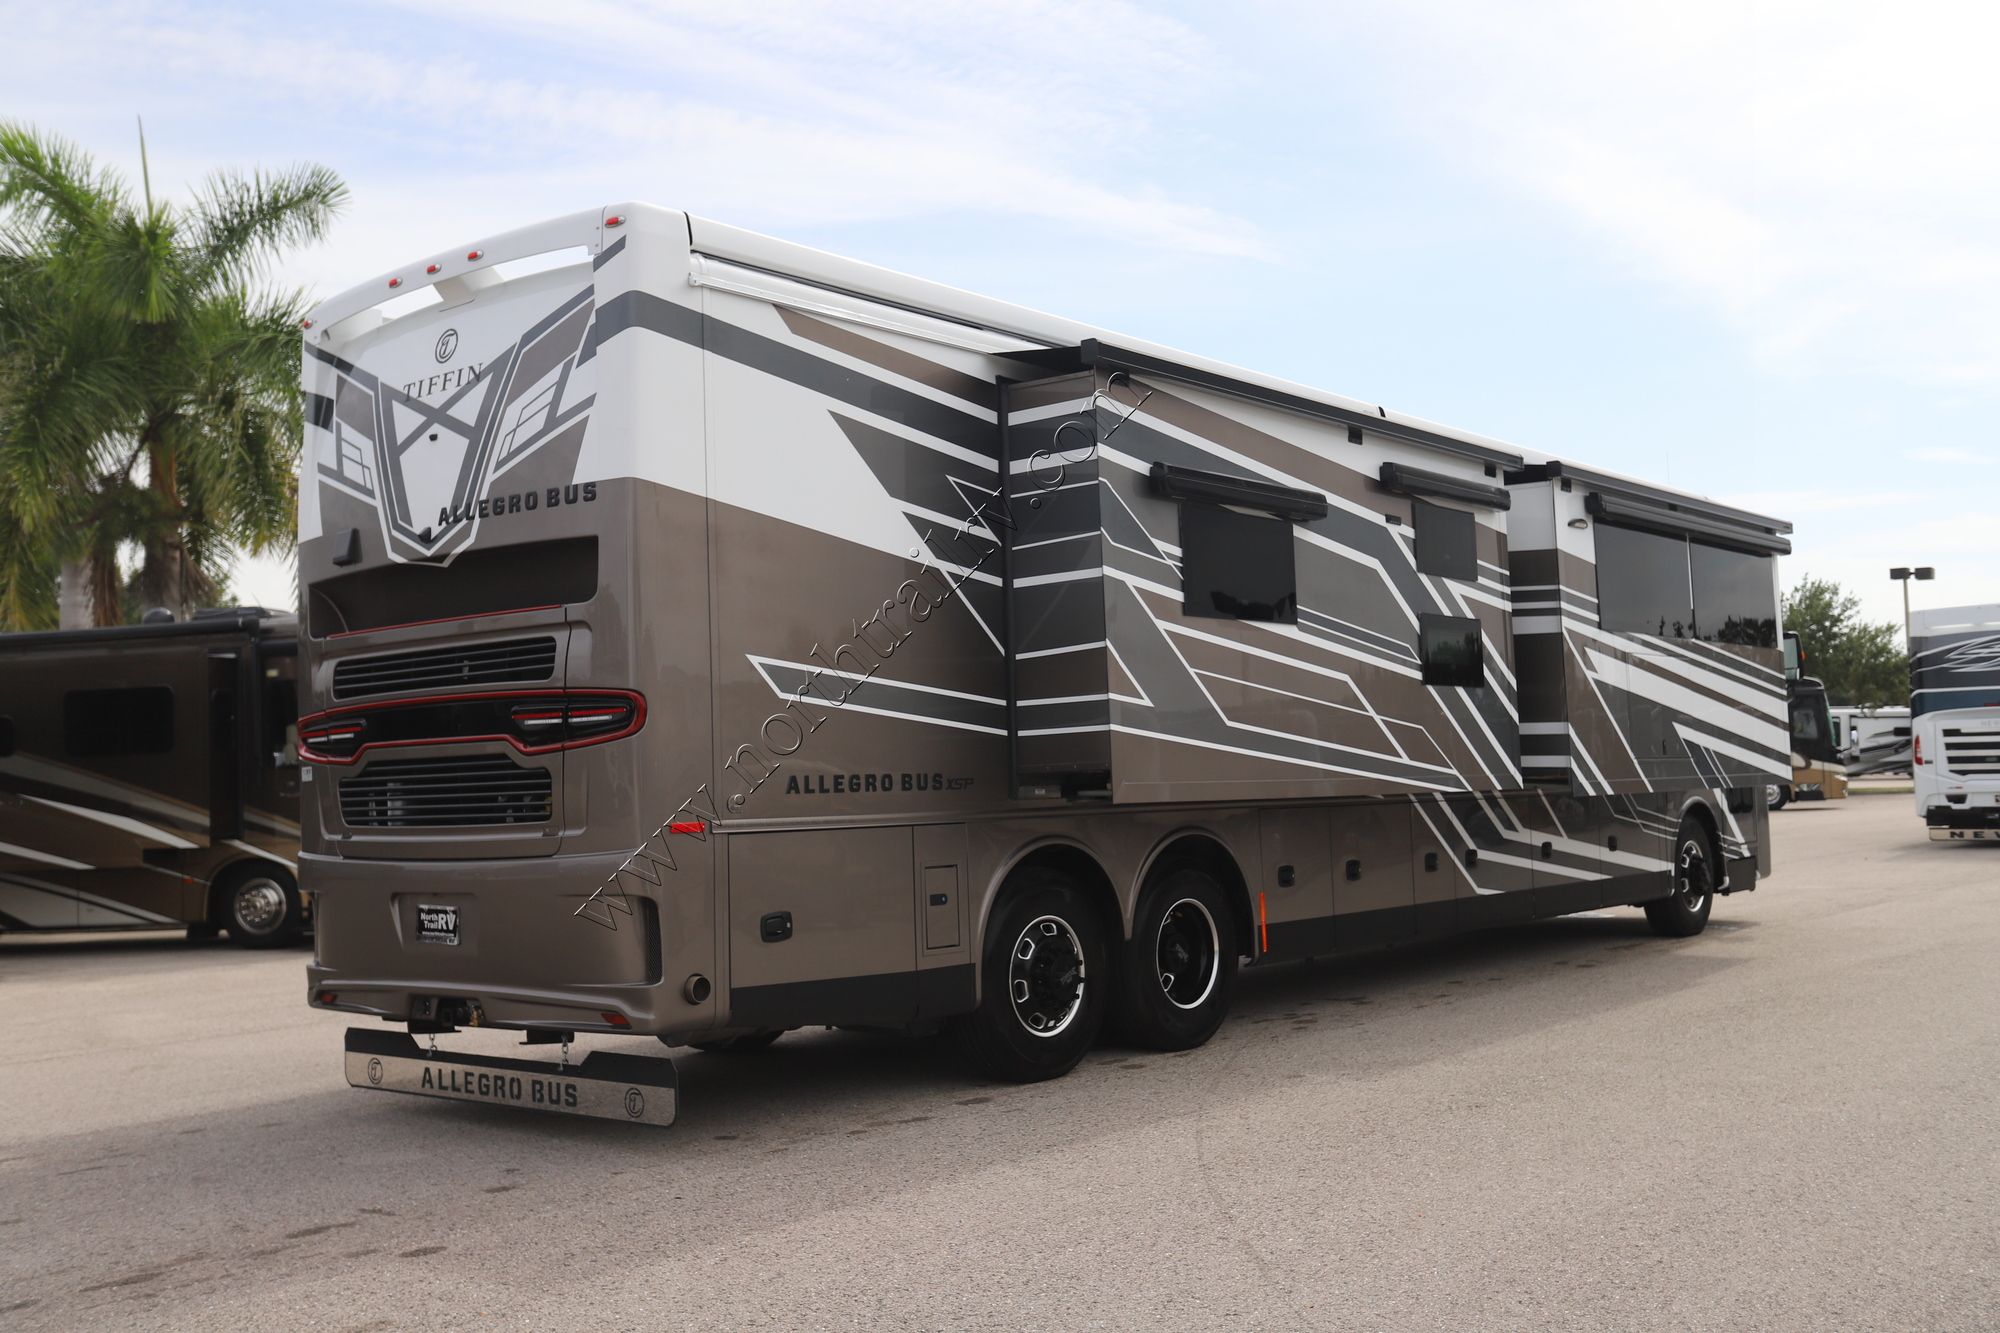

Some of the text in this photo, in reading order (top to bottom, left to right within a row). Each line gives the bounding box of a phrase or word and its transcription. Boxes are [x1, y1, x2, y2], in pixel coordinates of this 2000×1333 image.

[402, 363, 484, 401] TIFFIN
[438, 482, 598, 527] ALLEGRO BUS
[785, 773, 893, 795] ALLEGRO
[901, 773, 944, 792] BUS
[420, 912, 439, 921] North
[438, 913, 456, 930] RV
[421, 1066, 578, 1108] ALLEGRO BUS
